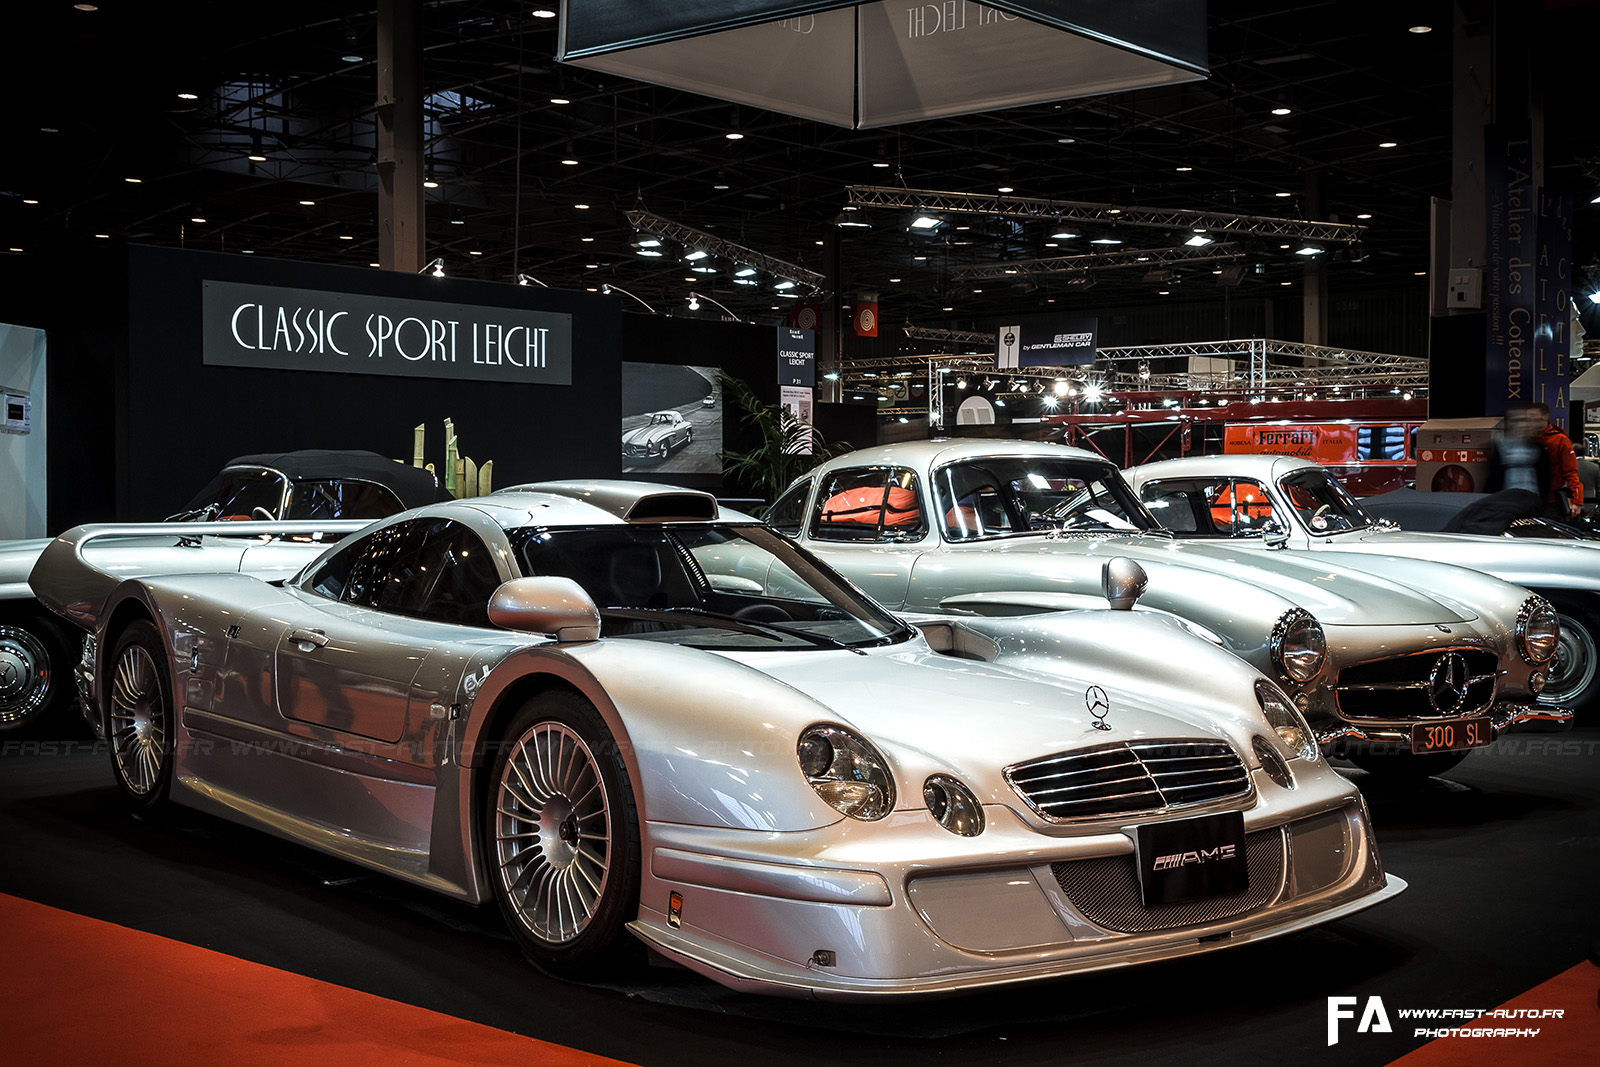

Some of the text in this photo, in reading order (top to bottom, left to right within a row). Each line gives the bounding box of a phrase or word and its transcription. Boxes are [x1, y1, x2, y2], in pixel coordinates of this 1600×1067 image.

[1507, 138, 1531, 399] L'Atelier des Coteaux
[231, 303, 549, 368] CLASSIC SPORT LEICHT
[1031, 342, 1073, 350] GENTLEMAN
[780, 350, 798, 358] CLASSIC
[1259, 430, 1315, 445] Ferrari
[1425, 722, 1483, 749] 300 SL
